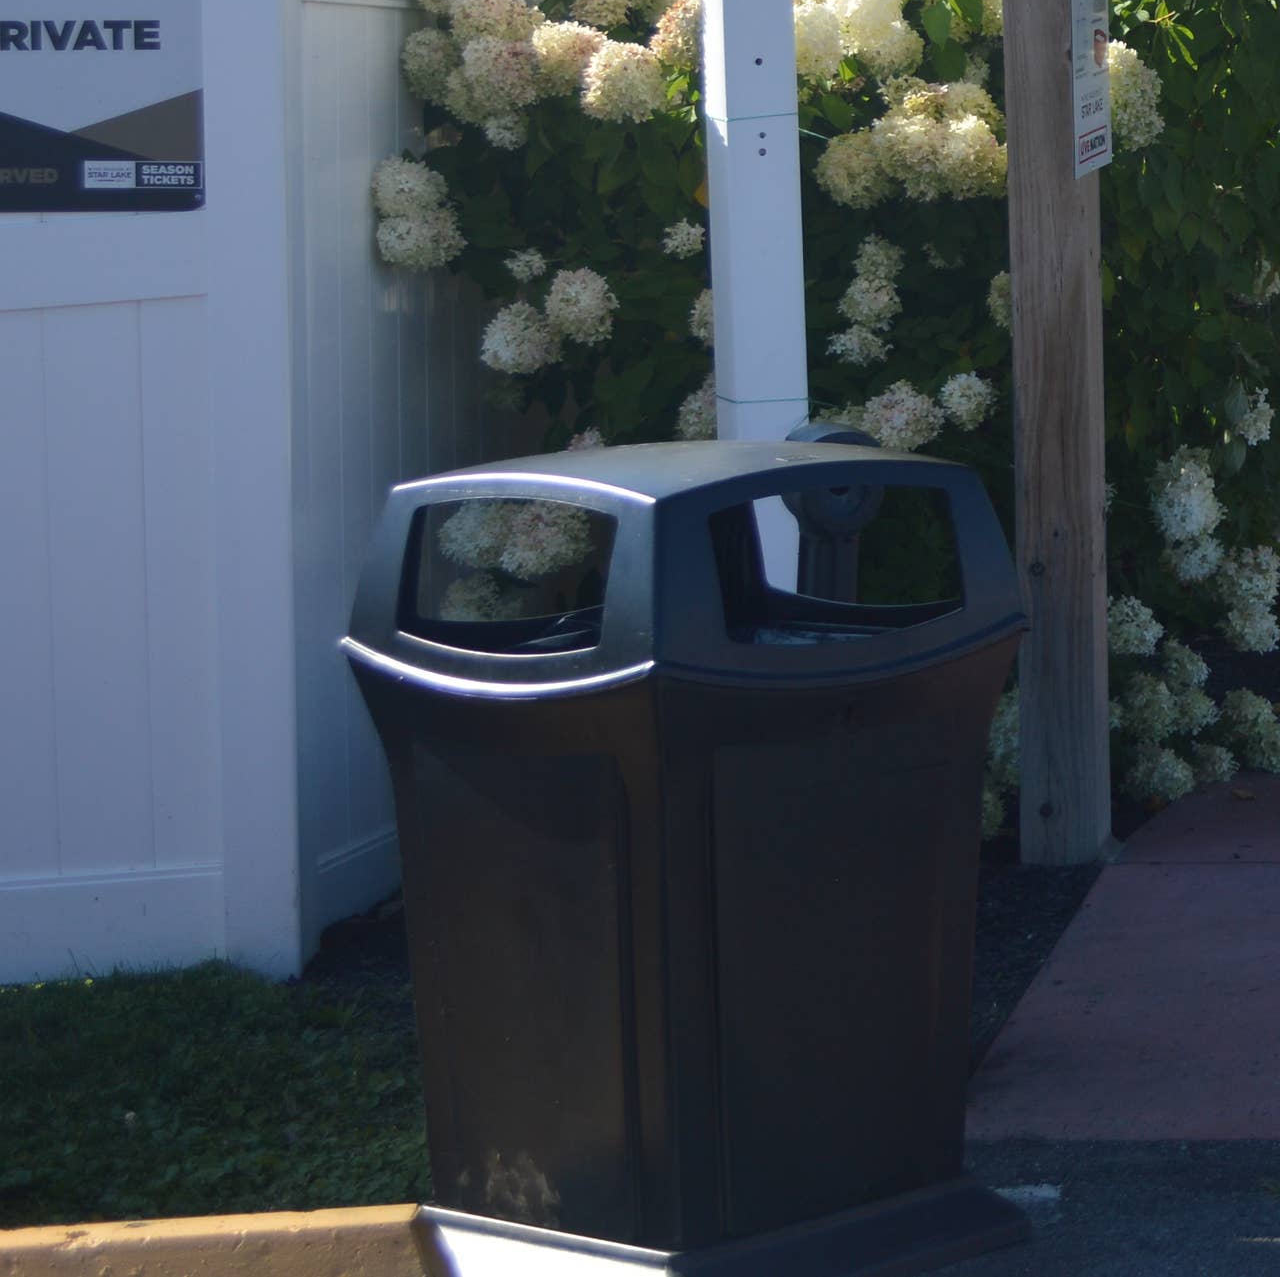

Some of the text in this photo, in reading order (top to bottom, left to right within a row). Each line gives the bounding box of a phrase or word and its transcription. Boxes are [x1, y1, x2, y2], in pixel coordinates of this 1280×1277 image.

[0, 20, 161, 51] RIVATE
[142, 165, 194, 174] SEASON
[88, 171, 132, 179] STAR LAKE
[142, 175, 195, 185] TICKETS
